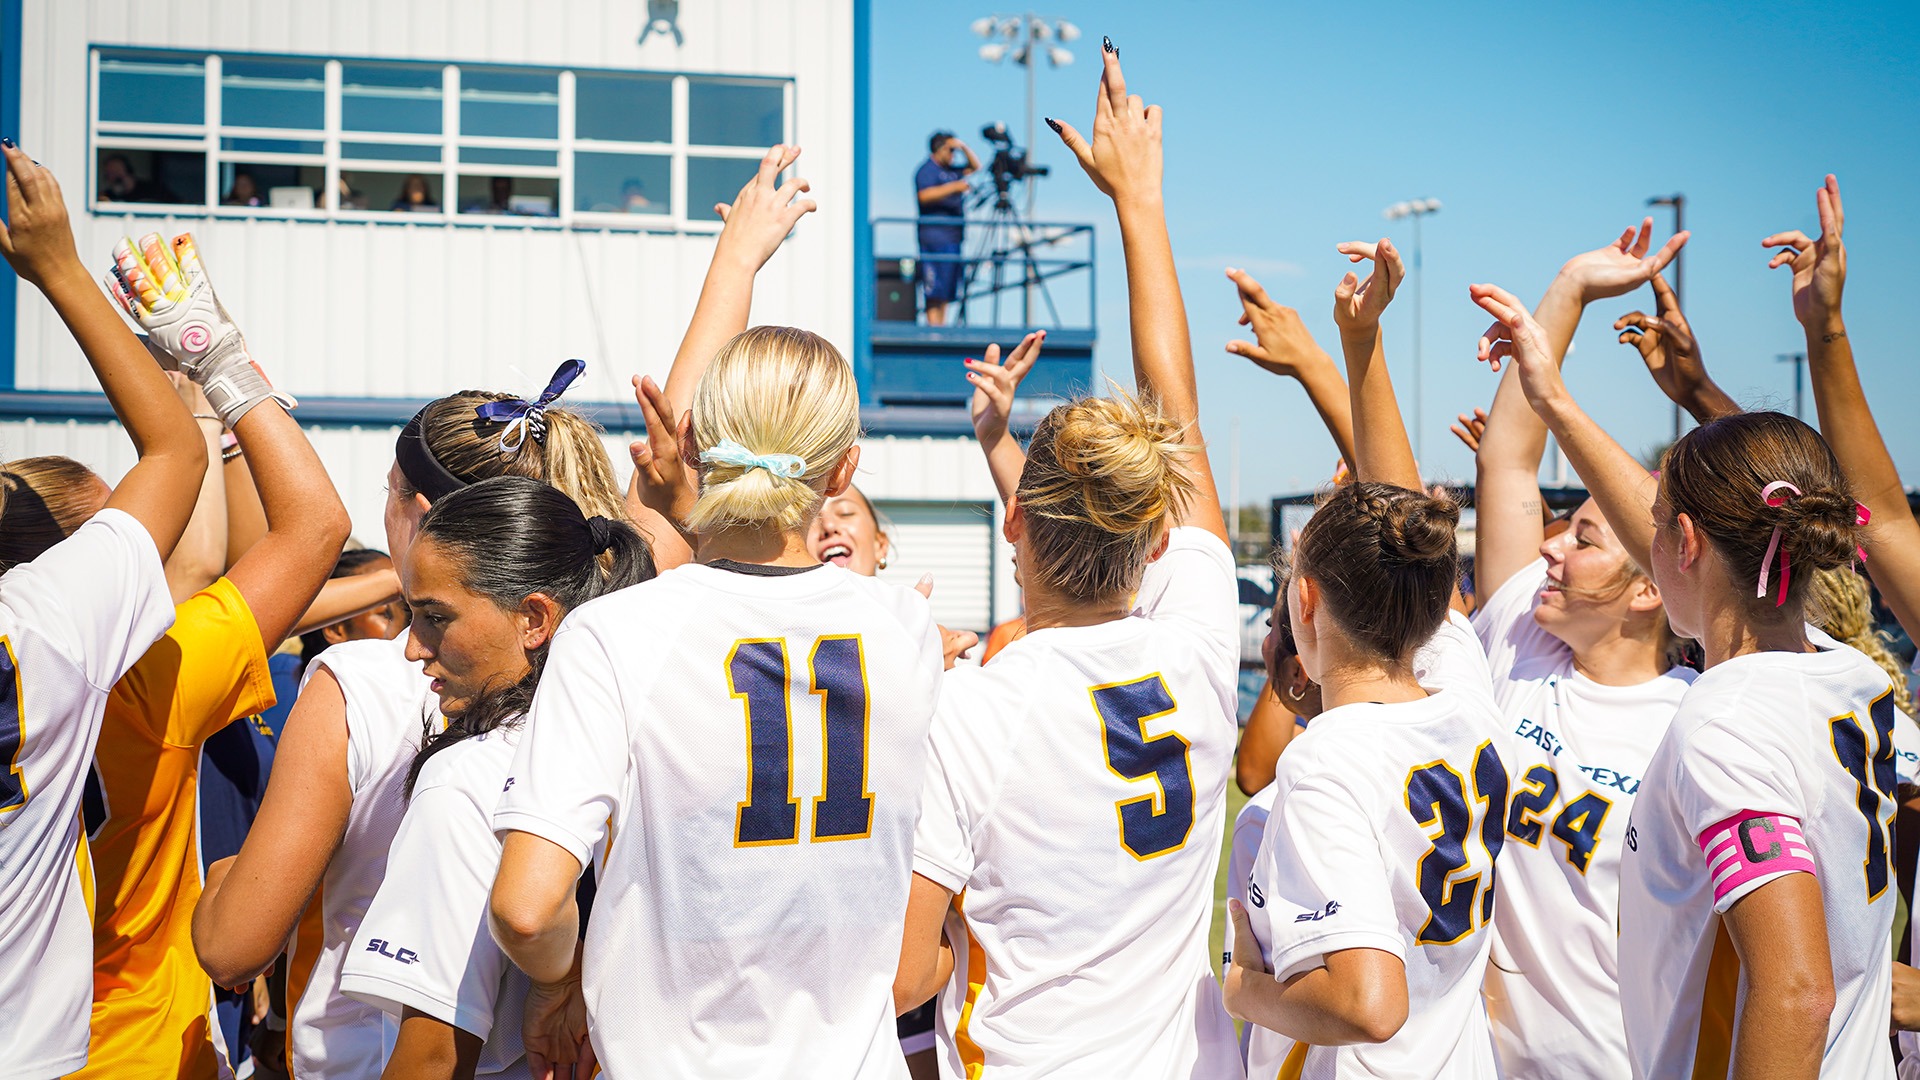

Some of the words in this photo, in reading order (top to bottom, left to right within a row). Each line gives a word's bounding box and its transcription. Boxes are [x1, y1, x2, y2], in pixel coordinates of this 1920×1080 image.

[725, 634, 875, 848] 11
[1088, 672, 1196, 862] 5
[1515, 718, 1563, 757] EAST
[1404, 738, 1511, 946] 21
[1506, 763, 1615, 877] 24
[1738, 817, 1782, 864] C
[365, 938, 420, 965] SLC
